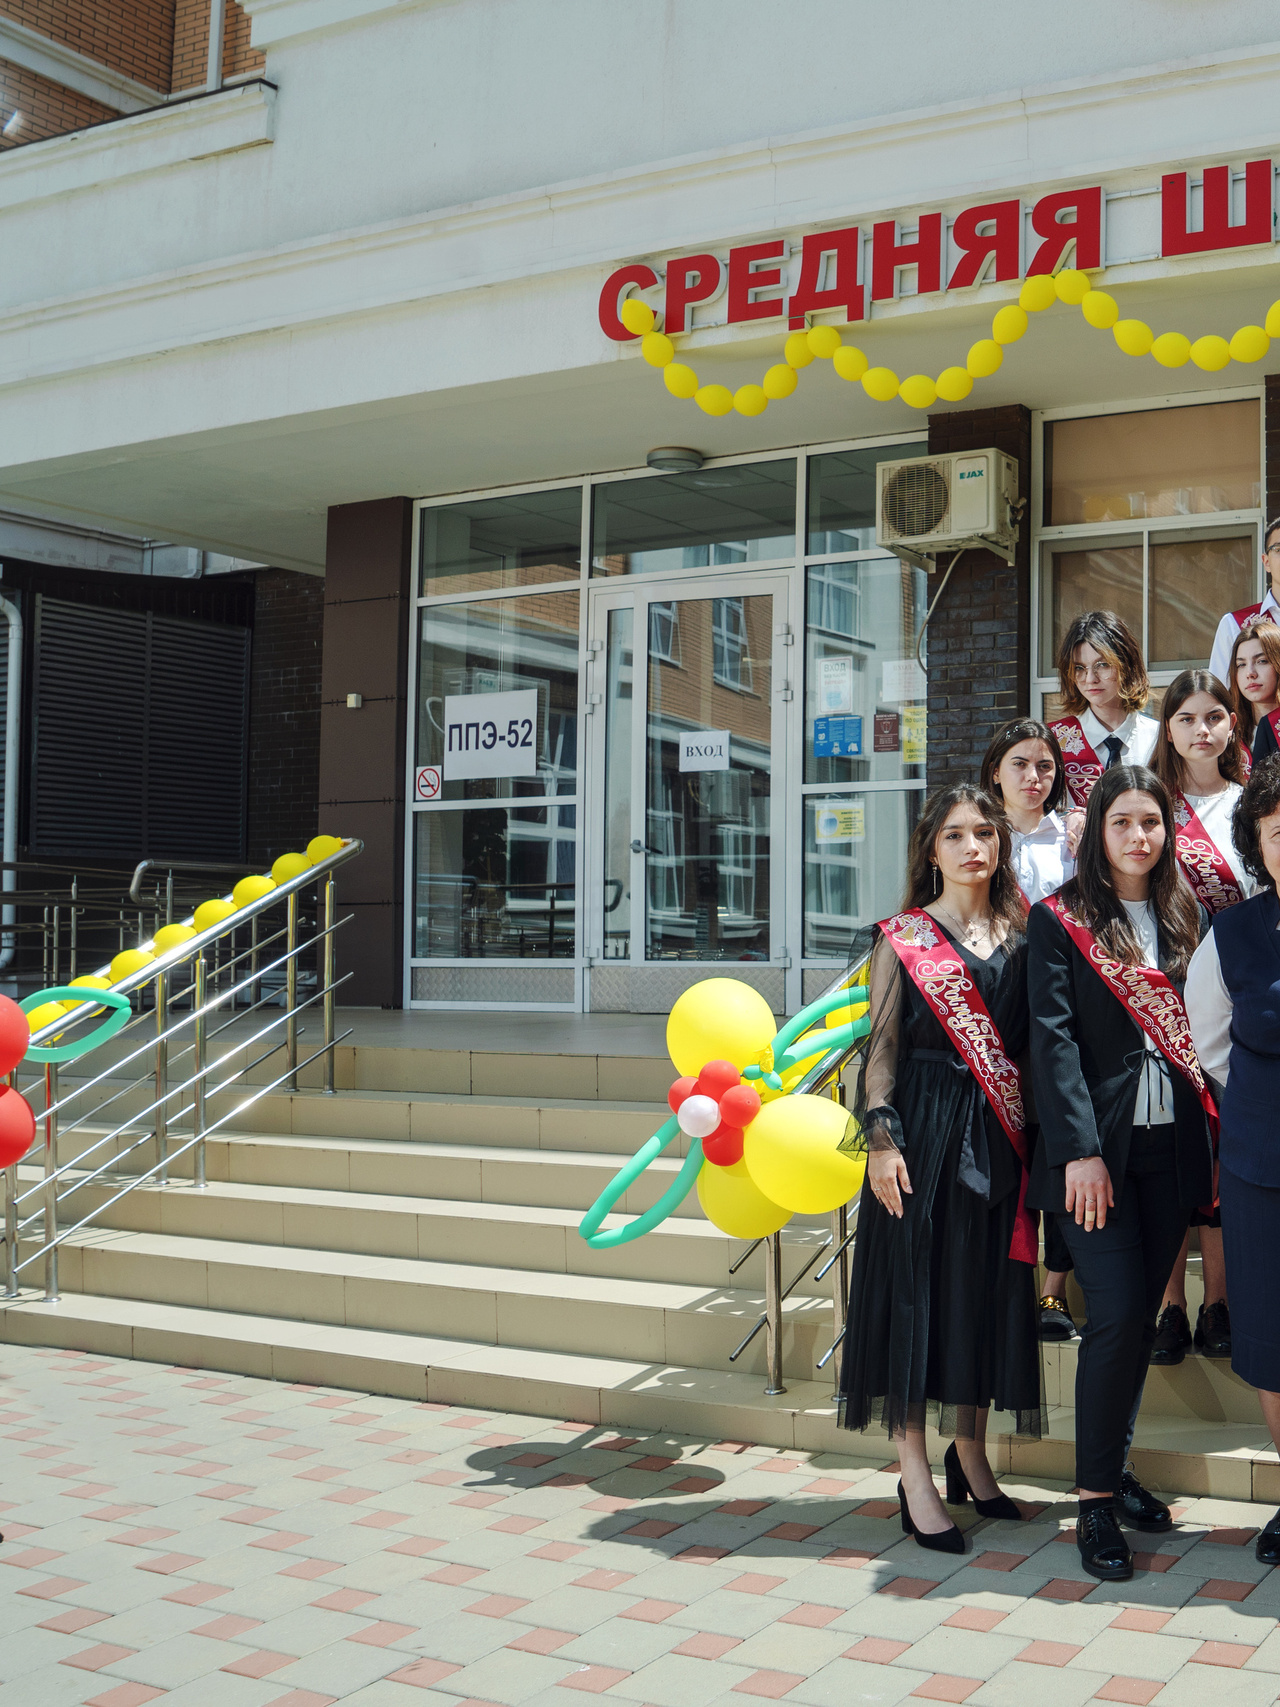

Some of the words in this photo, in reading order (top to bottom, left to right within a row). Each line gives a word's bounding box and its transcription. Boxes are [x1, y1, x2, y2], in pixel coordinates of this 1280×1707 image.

[599, 186, 1103, 341] СРЕДНЯЯ
[448, 719, 533, 752] ППЭ-52
[686, 745, 723, 758] ВХОД
[915, 959, 1019, 1081] Выпускник
[997, 1078, 1026, 1131] 2022
